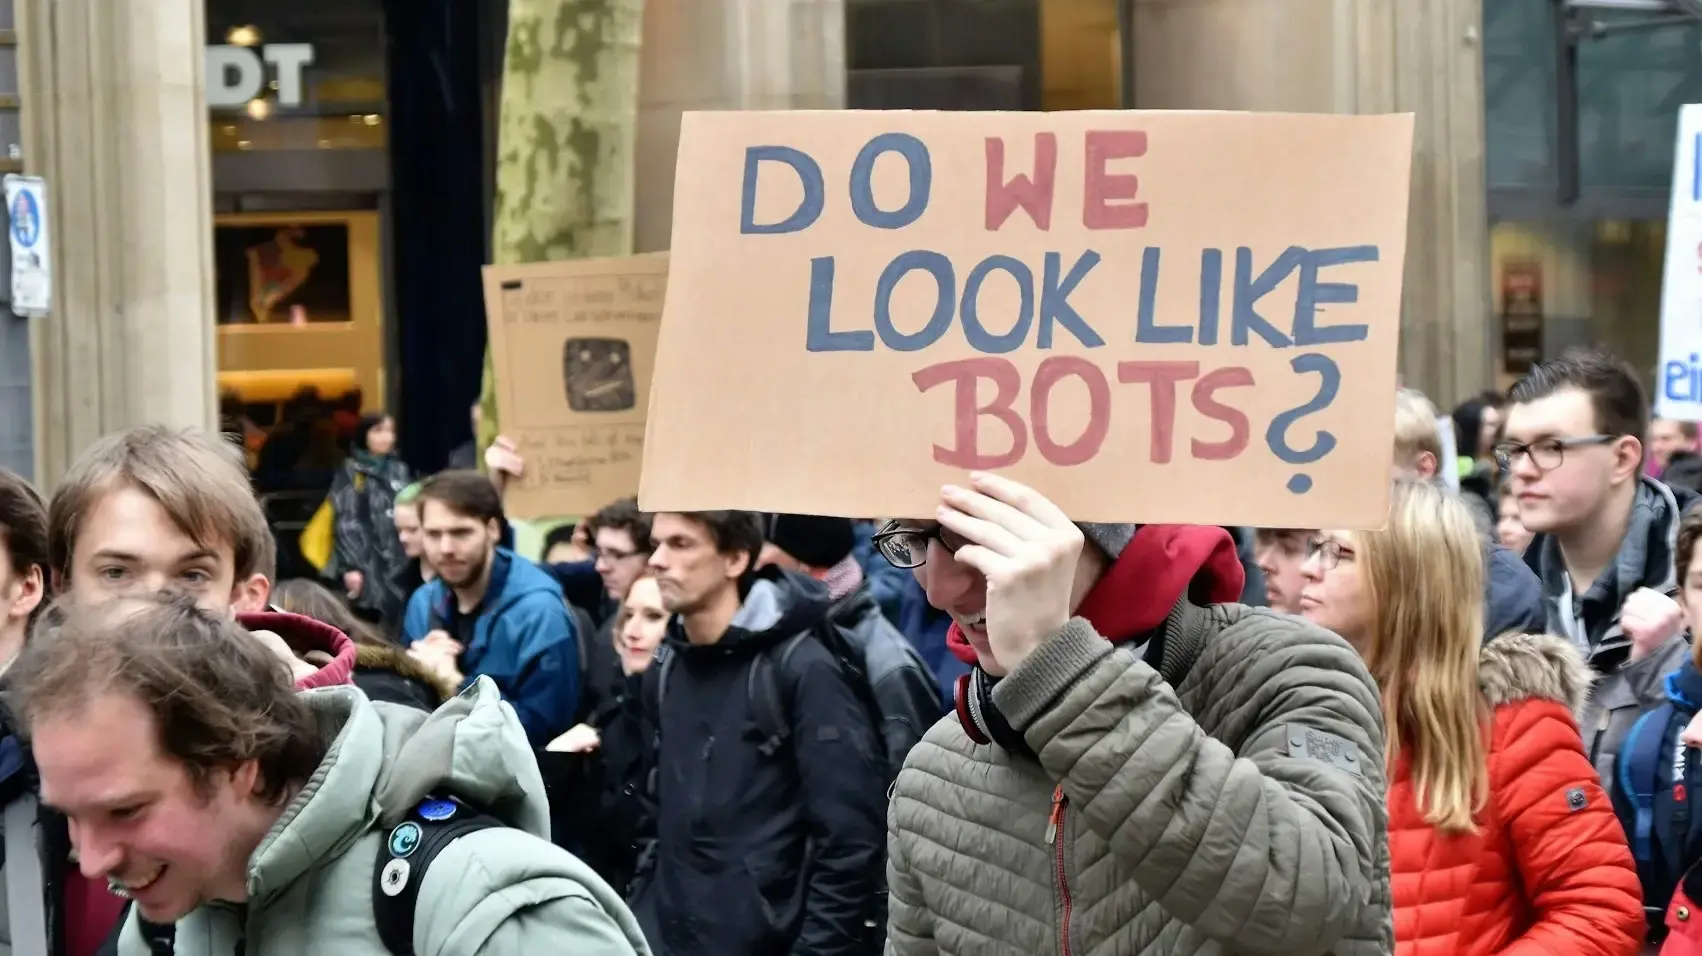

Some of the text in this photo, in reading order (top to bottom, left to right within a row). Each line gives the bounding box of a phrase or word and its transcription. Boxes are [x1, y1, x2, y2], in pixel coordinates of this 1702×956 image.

[740, 130, 1149, 235] DO WE
[806, 245, 1380, 353] LOOK LIKE
[912, 353, 1341, 495] BOTS?
